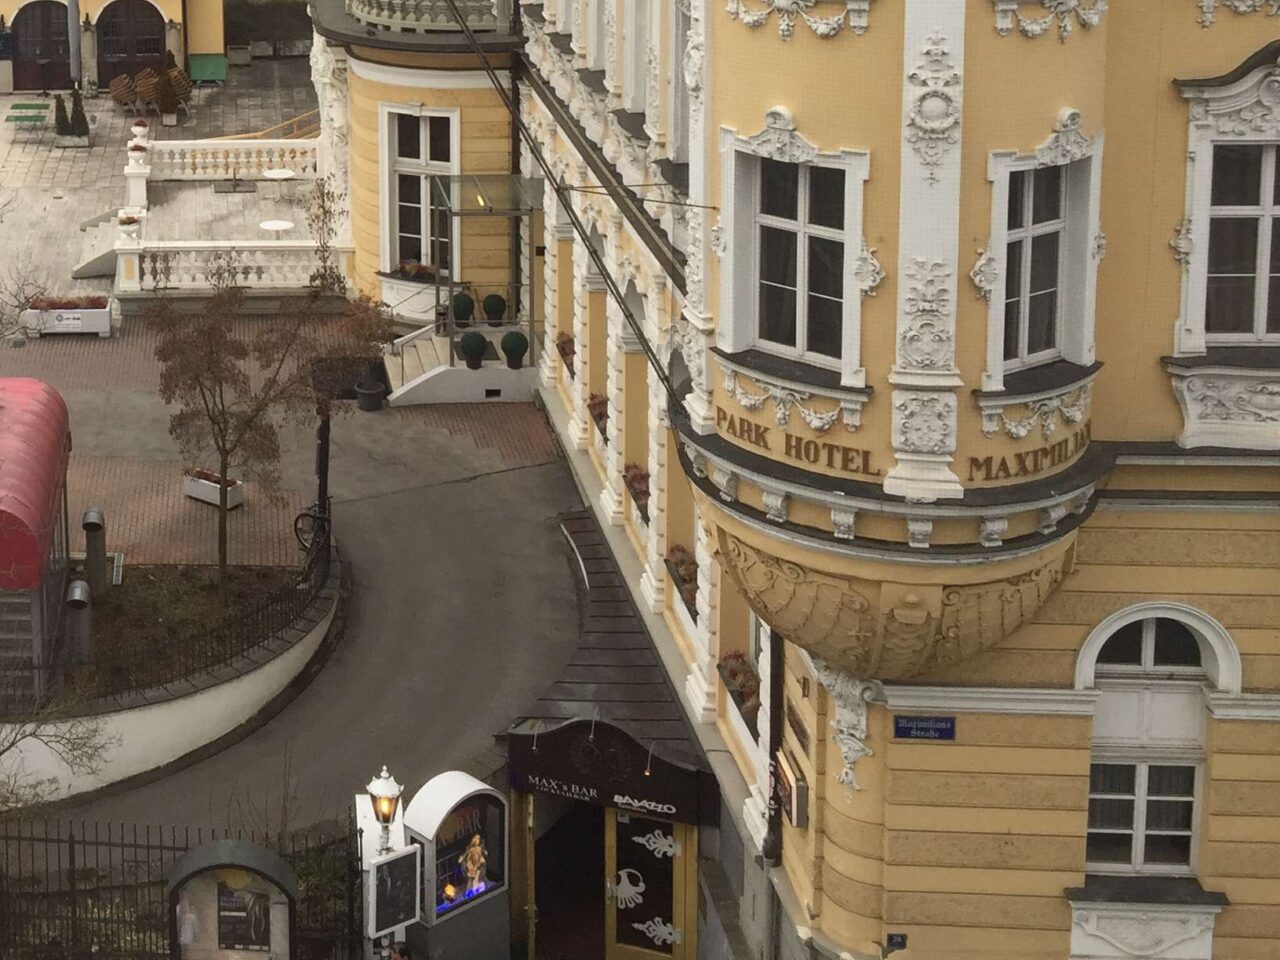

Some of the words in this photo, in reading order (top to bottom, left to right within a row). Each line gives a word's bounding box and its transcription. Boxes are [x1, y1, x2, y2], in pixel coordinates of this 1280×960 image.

[716, 406, 771, 451] PARK
[784, 432, 881, 477] HOTEL
[571, 783, 598, 799] BAR
[613, 794, 677, 815] BAJAZZO
